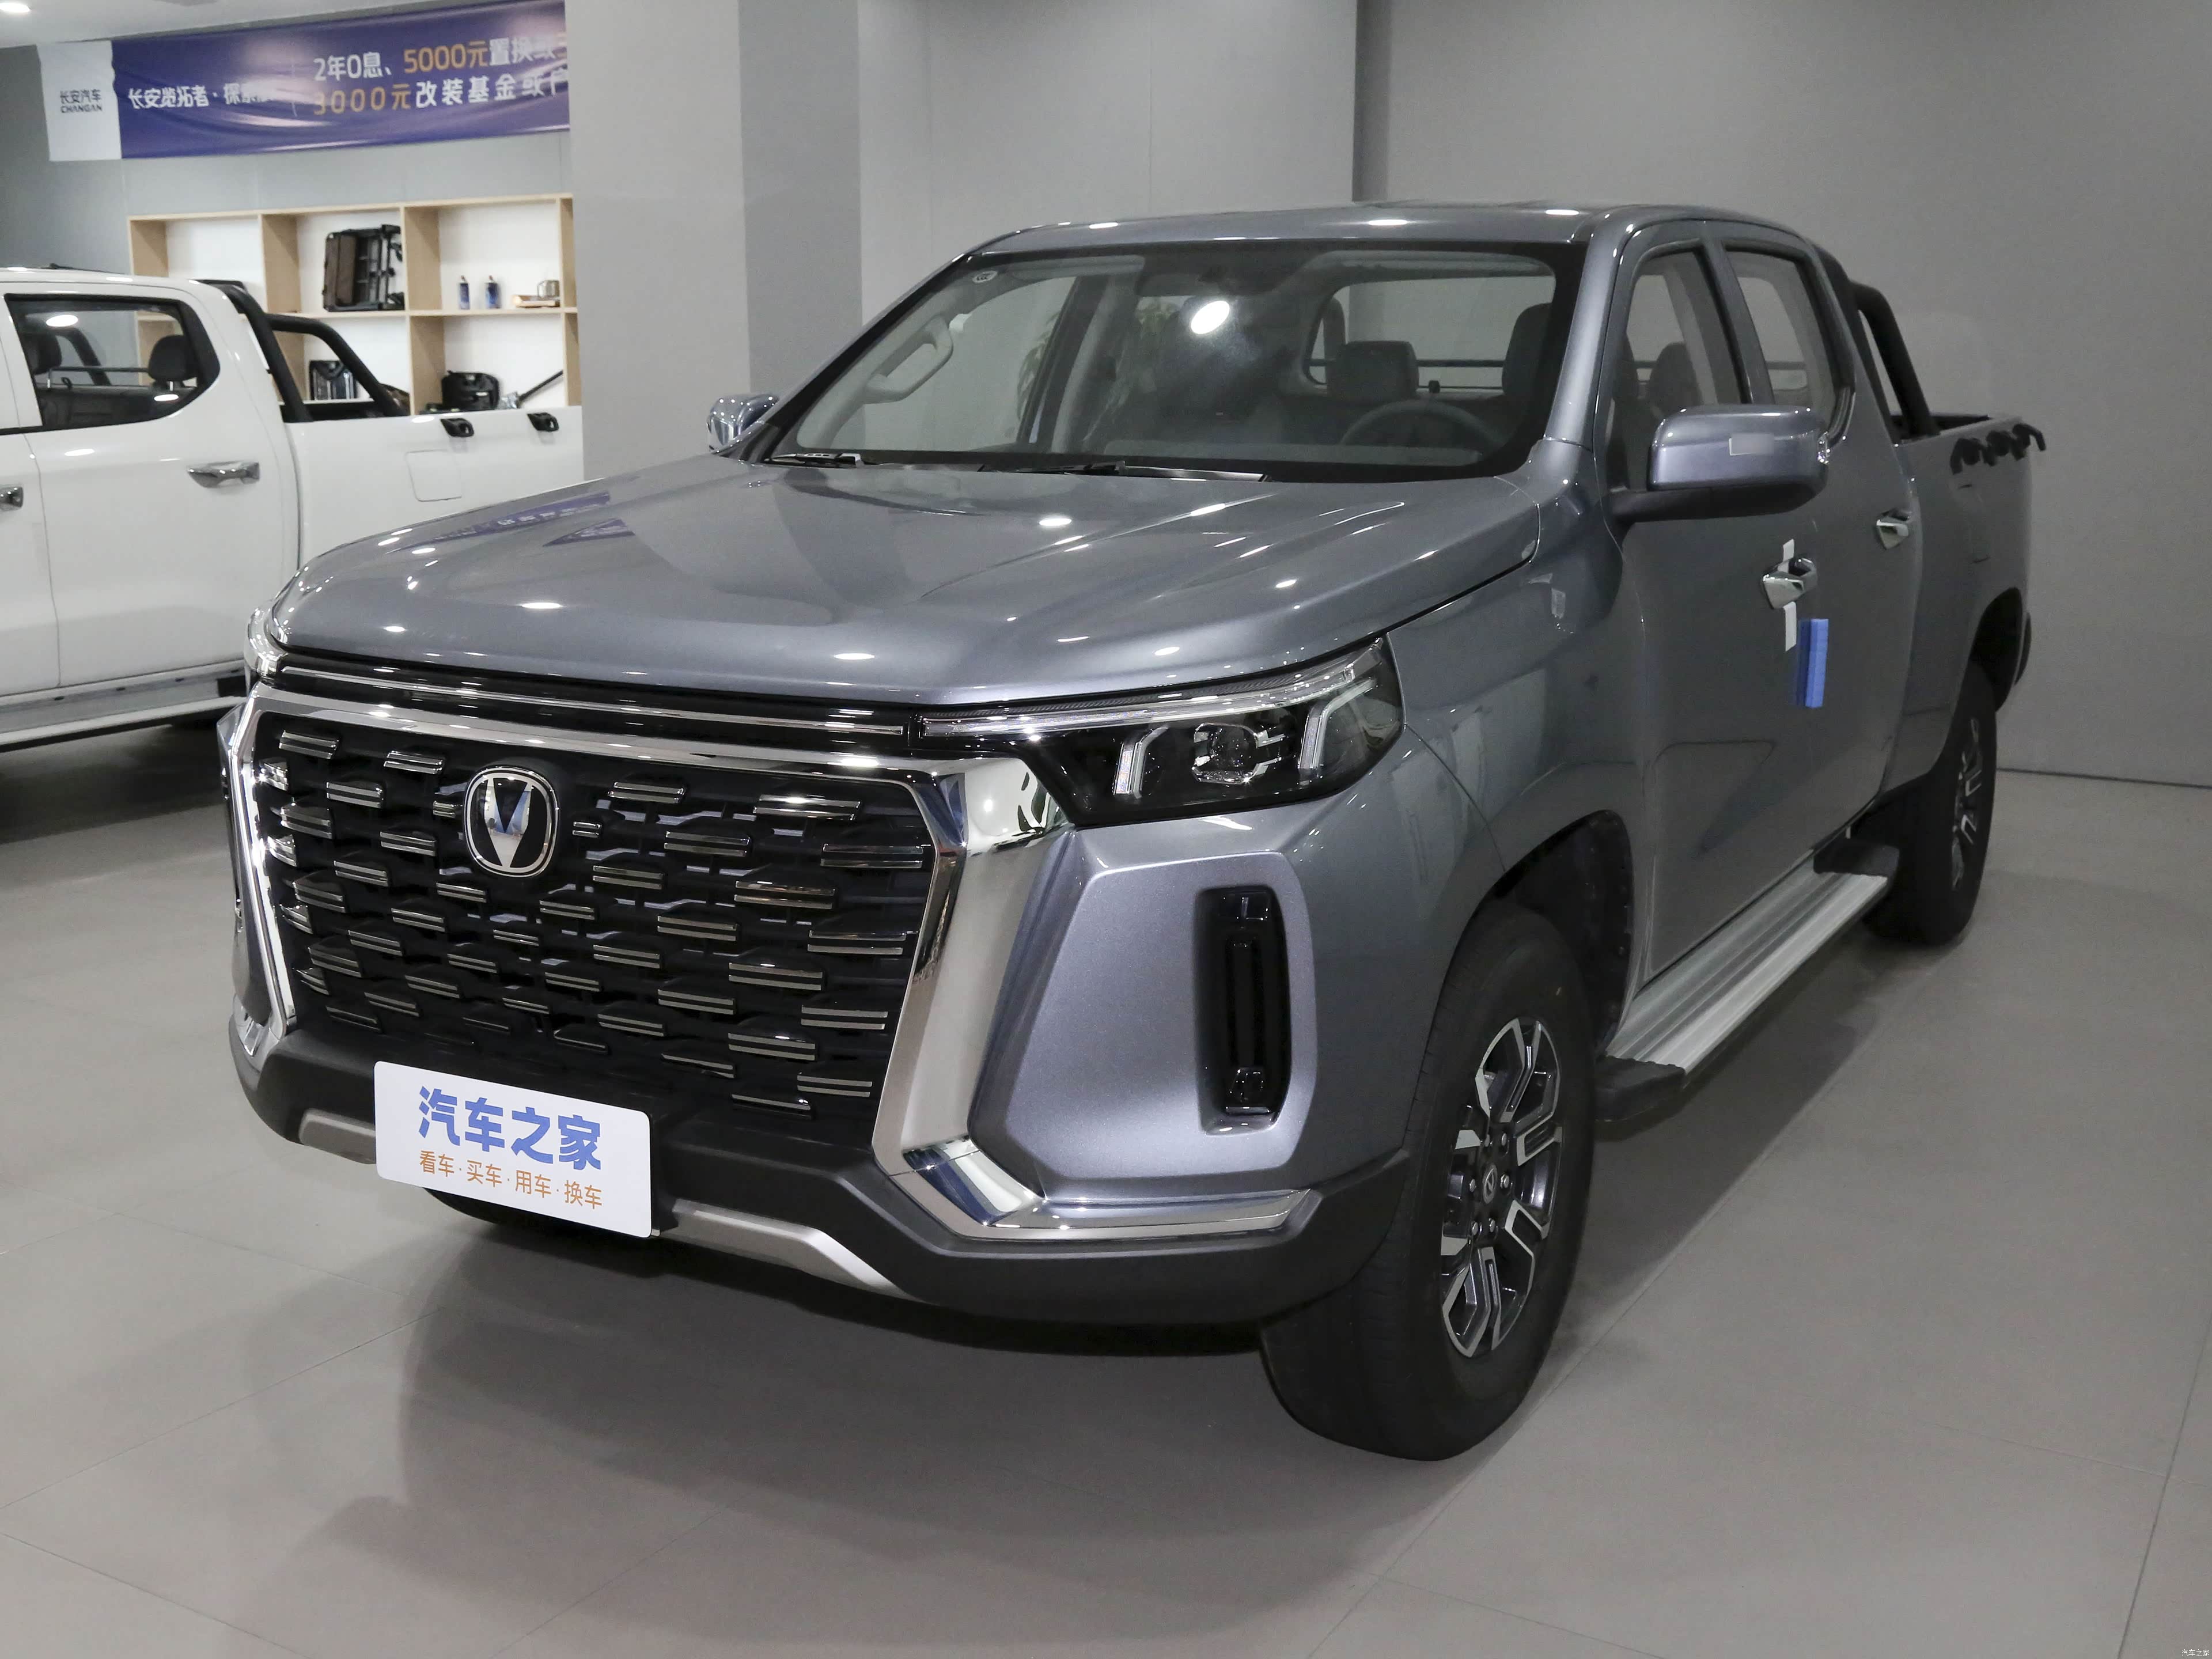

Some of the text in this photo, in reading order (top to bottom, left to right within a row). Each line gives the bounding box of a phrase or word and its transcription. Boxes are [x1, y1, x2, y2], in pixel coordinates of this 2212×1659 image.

[59, 89, 101, 104] 长安汽车
[60, 104, 103, 113] CHANGAN
[418, 1085, 601, 1171] 汽车之家
